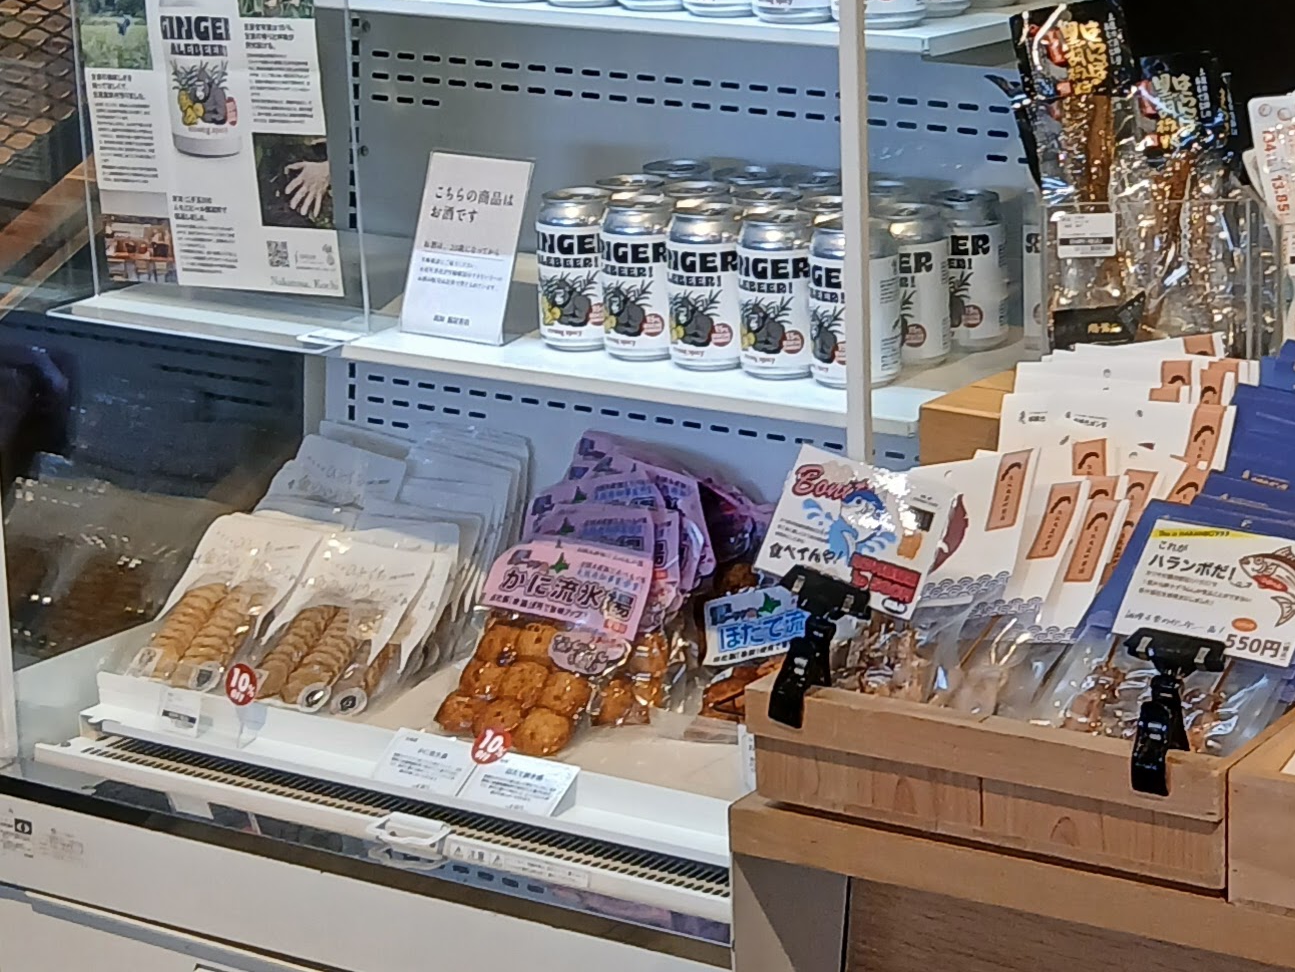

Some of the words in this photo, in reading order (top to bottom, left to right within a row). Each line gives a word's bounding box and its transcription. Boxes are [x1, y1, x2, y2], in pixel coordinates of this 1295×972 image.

[434, 185, 515, 207] こちらの商品は
[1158, 540, 1188, 553] これが
[1148, 554, 1237, 581] ハランボだ!
[1225, 634, 1282, 659] 550円
